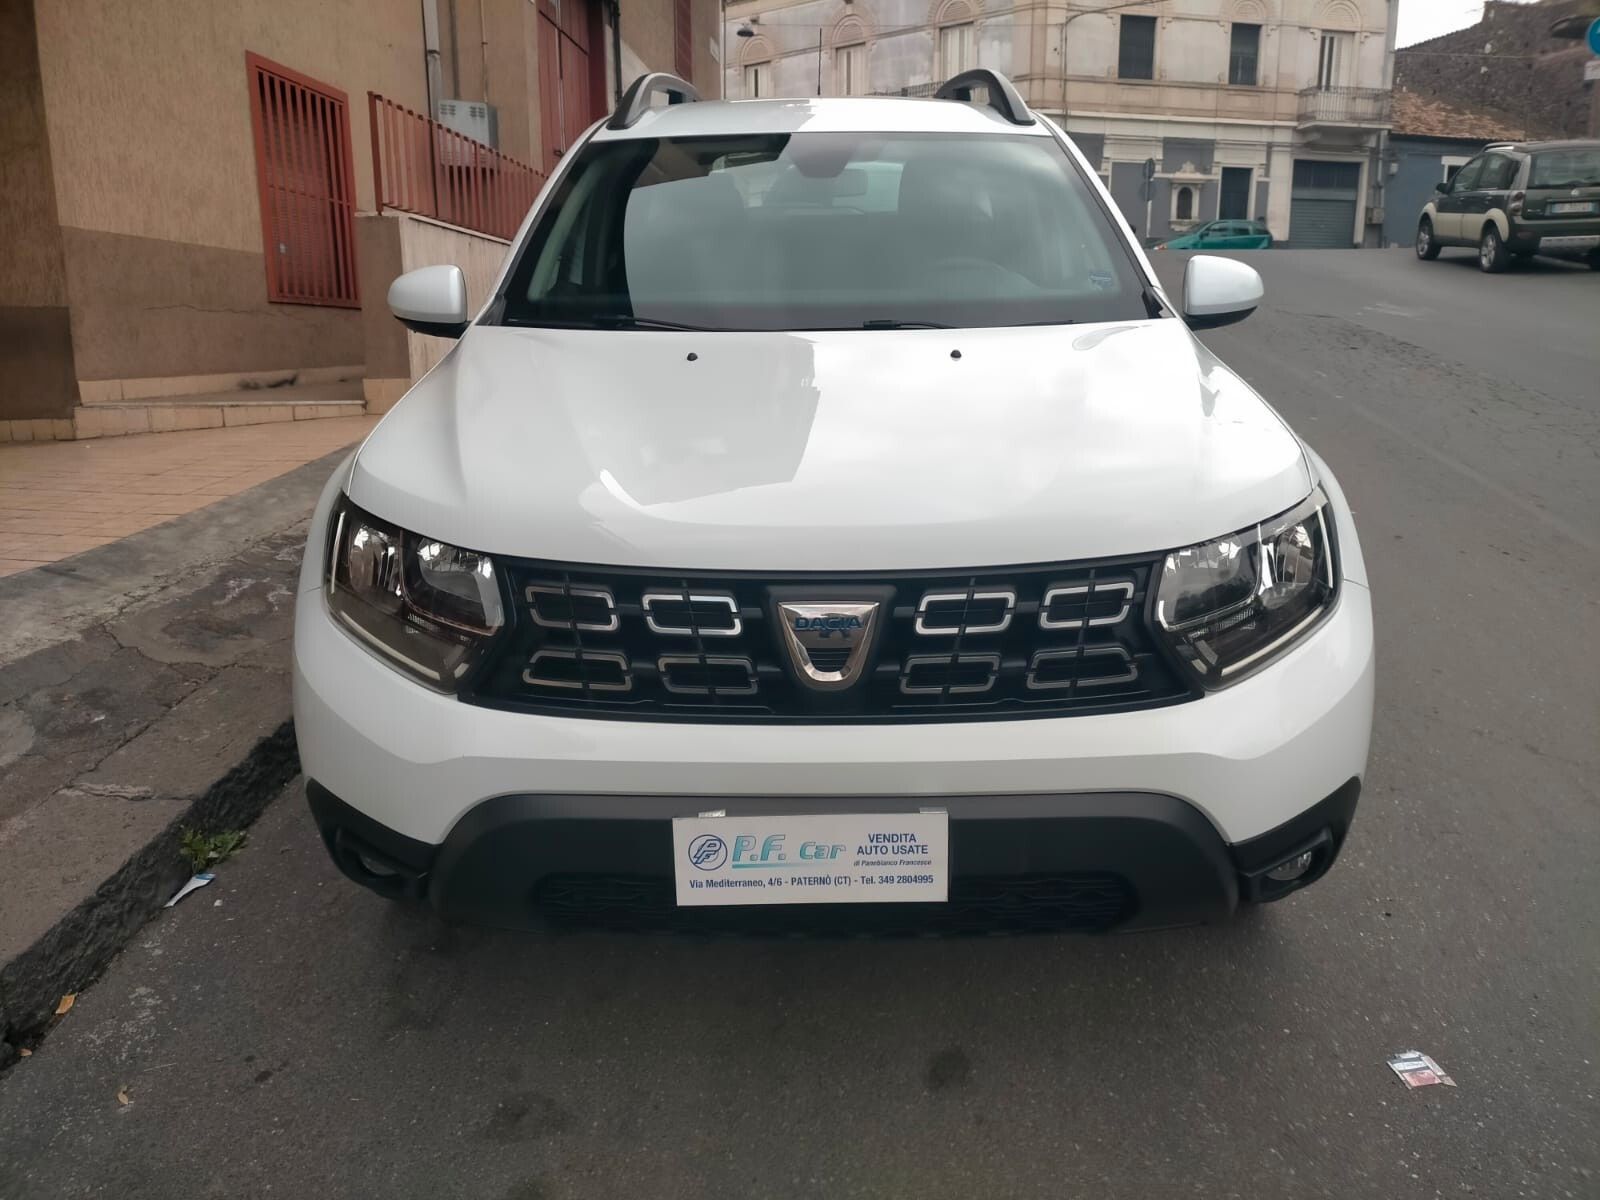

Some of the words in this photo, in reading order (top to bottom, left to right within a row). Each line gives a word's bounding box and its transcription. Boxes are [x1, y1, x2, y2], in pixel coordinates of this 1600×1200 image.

[795, 617, 864, 631] DACIA
[868, 833, 917, 843] VENDITA
[732, 834, 786, 862] P.F.
[799, 841, 847, 860] Car
[857, 845, 889, 855] AUTO
[892, 844, 929, 854] USATE
[689, 880, 704, 889] Via
[705, 879, 766, 889] Mediterraneo,
[767, 877, 783, 887] 4/6
[791, 874, 832, 886] PATERNÒ
[834, 875, 852, 887] (CT)
[860, 876, 876, 885] Tel.
[878, 875, 895, 885] 349
[896, 874, 934, 884] 2804995
